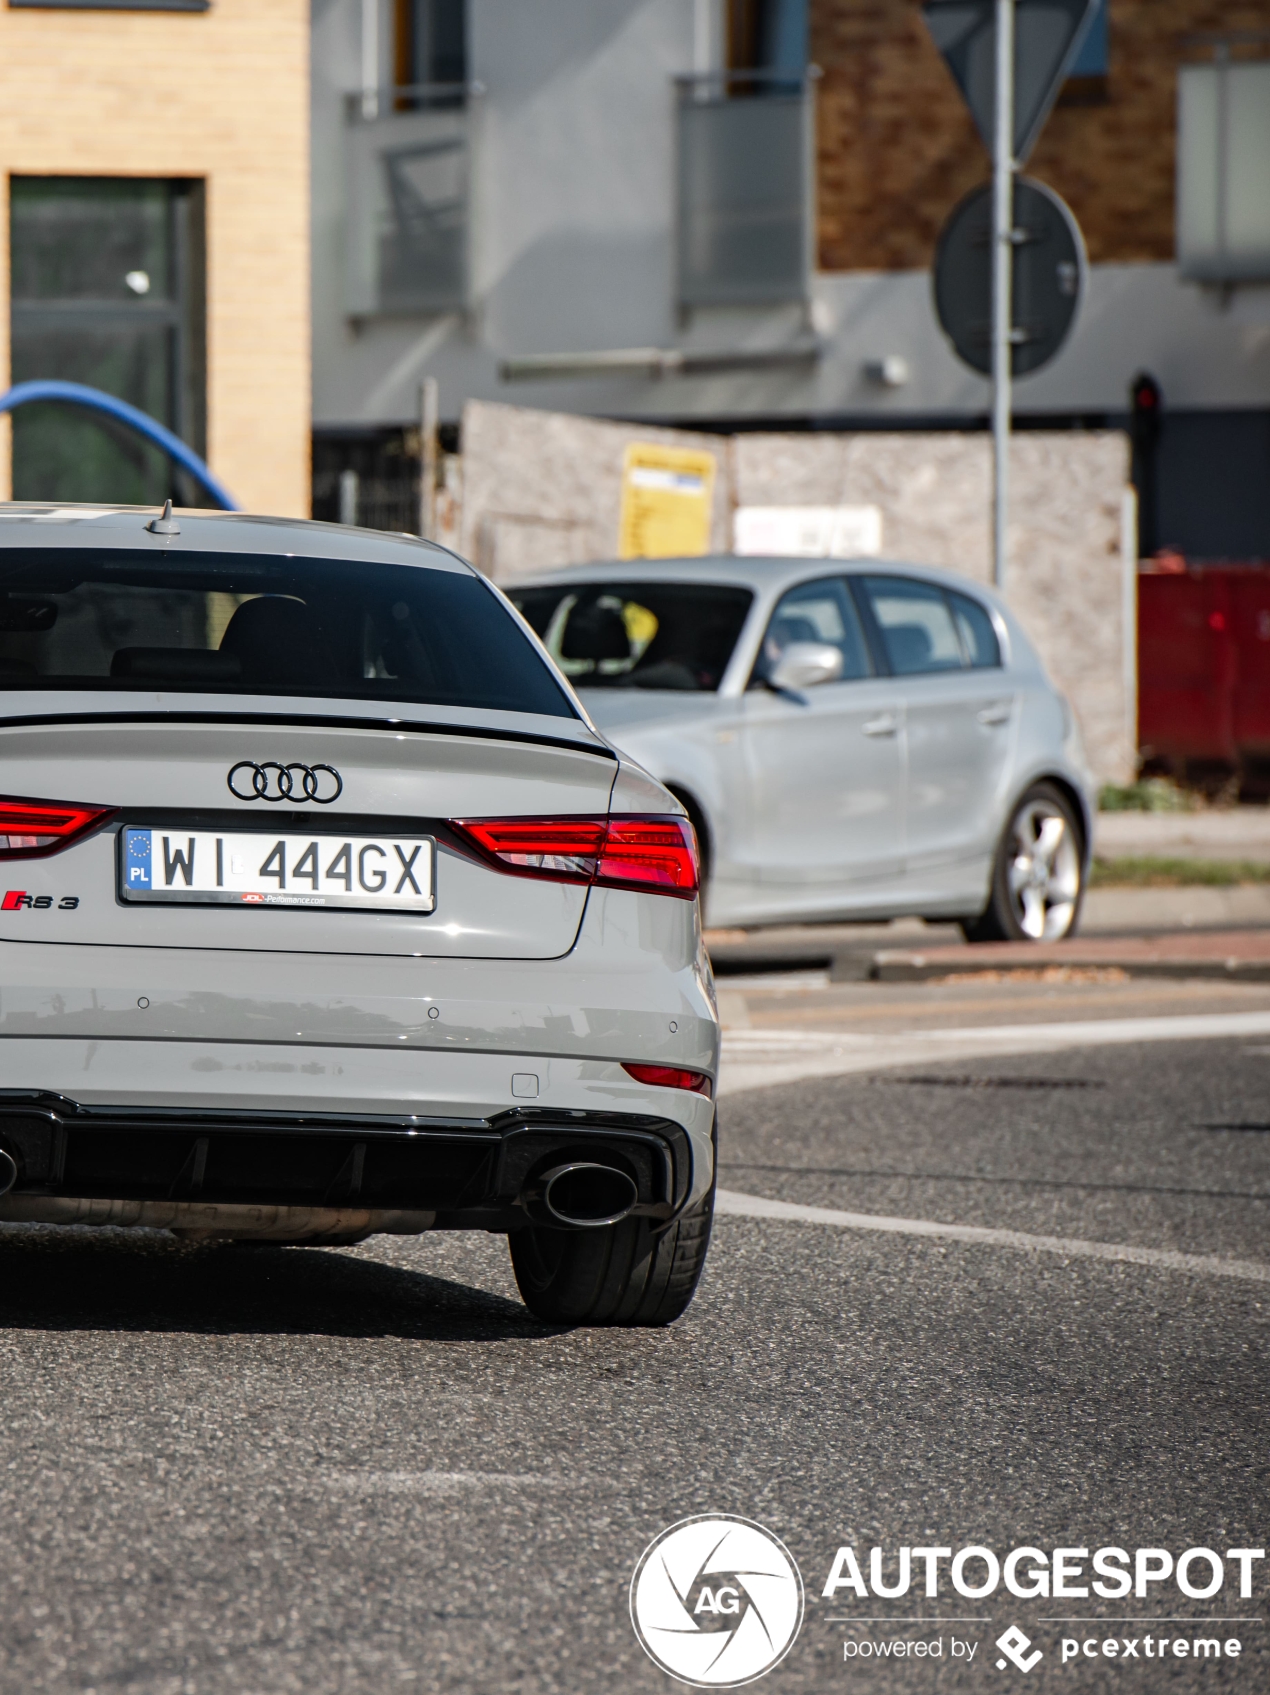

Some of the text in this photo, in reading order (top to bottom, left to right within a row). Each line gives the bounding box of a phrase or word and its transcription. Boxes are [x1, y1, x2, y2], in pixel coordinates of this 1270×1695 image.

[162, 836, 422, 895] WI 444GX
[130, 867, 149, 881] PL
[14, 895, 80, 909] RS 3
